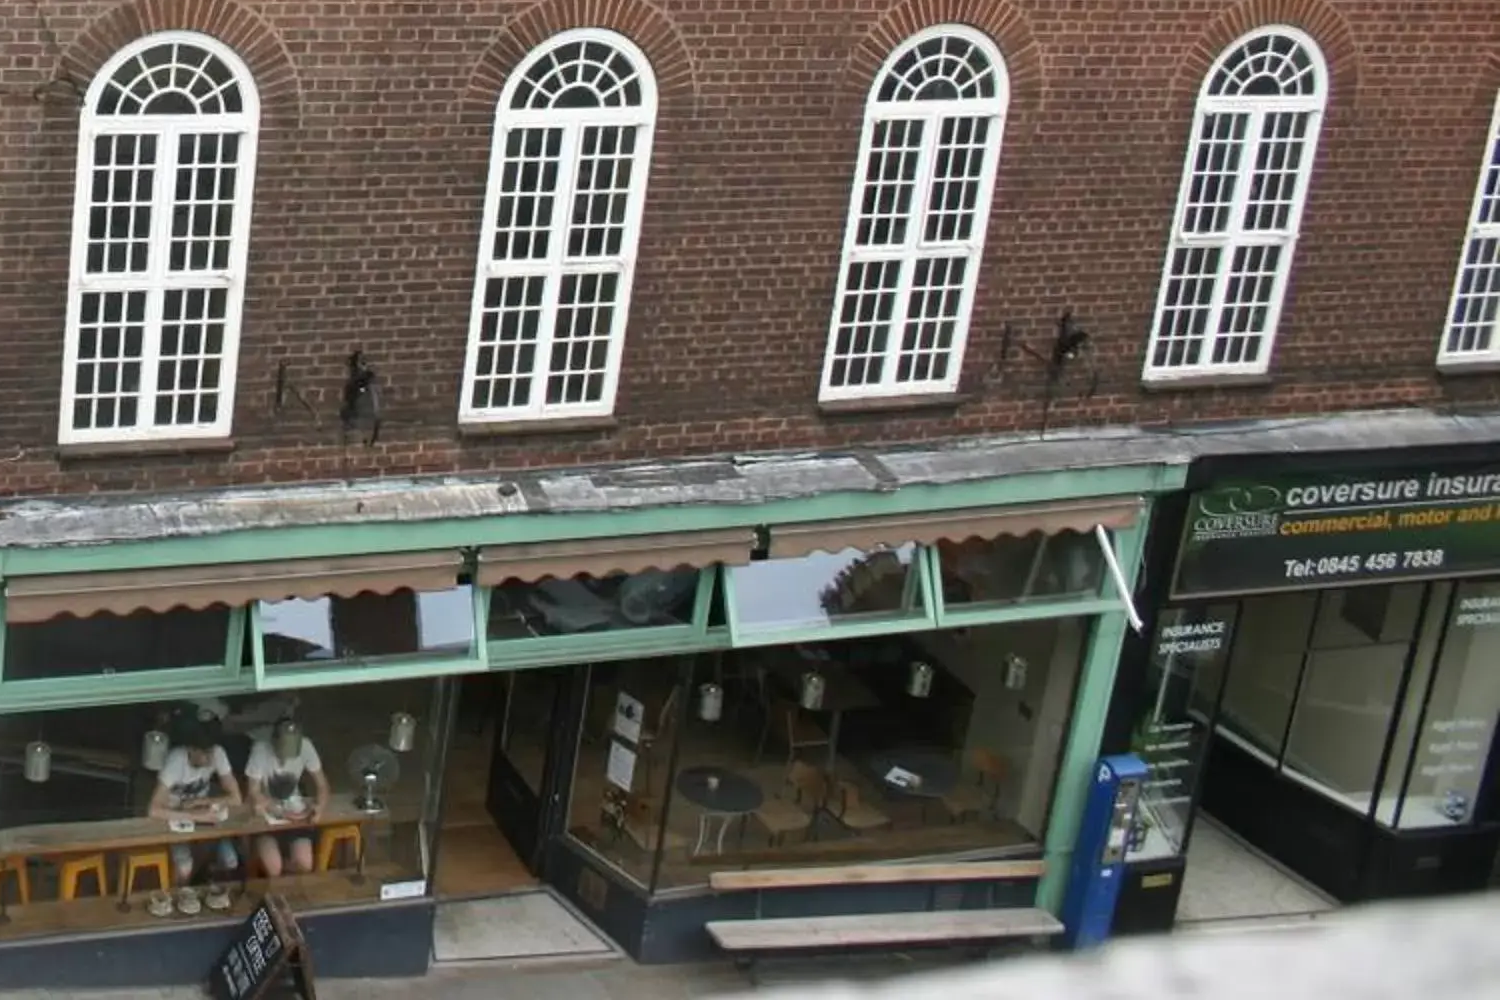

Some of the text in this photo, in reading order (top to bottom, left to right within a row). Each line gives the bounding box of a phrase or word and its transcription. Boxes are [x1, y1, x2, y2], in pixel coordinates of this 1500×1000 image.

[1286, 478, 1419, 506] coversure
[1398, 508, 1451, 526] motor
[1456, 504, 1492, 522] and
[1365, 553, 1397, 571] 456
[1403, 549, 1444, 569] 7838
[1161, 621, 1225, 638] INSURANCE
